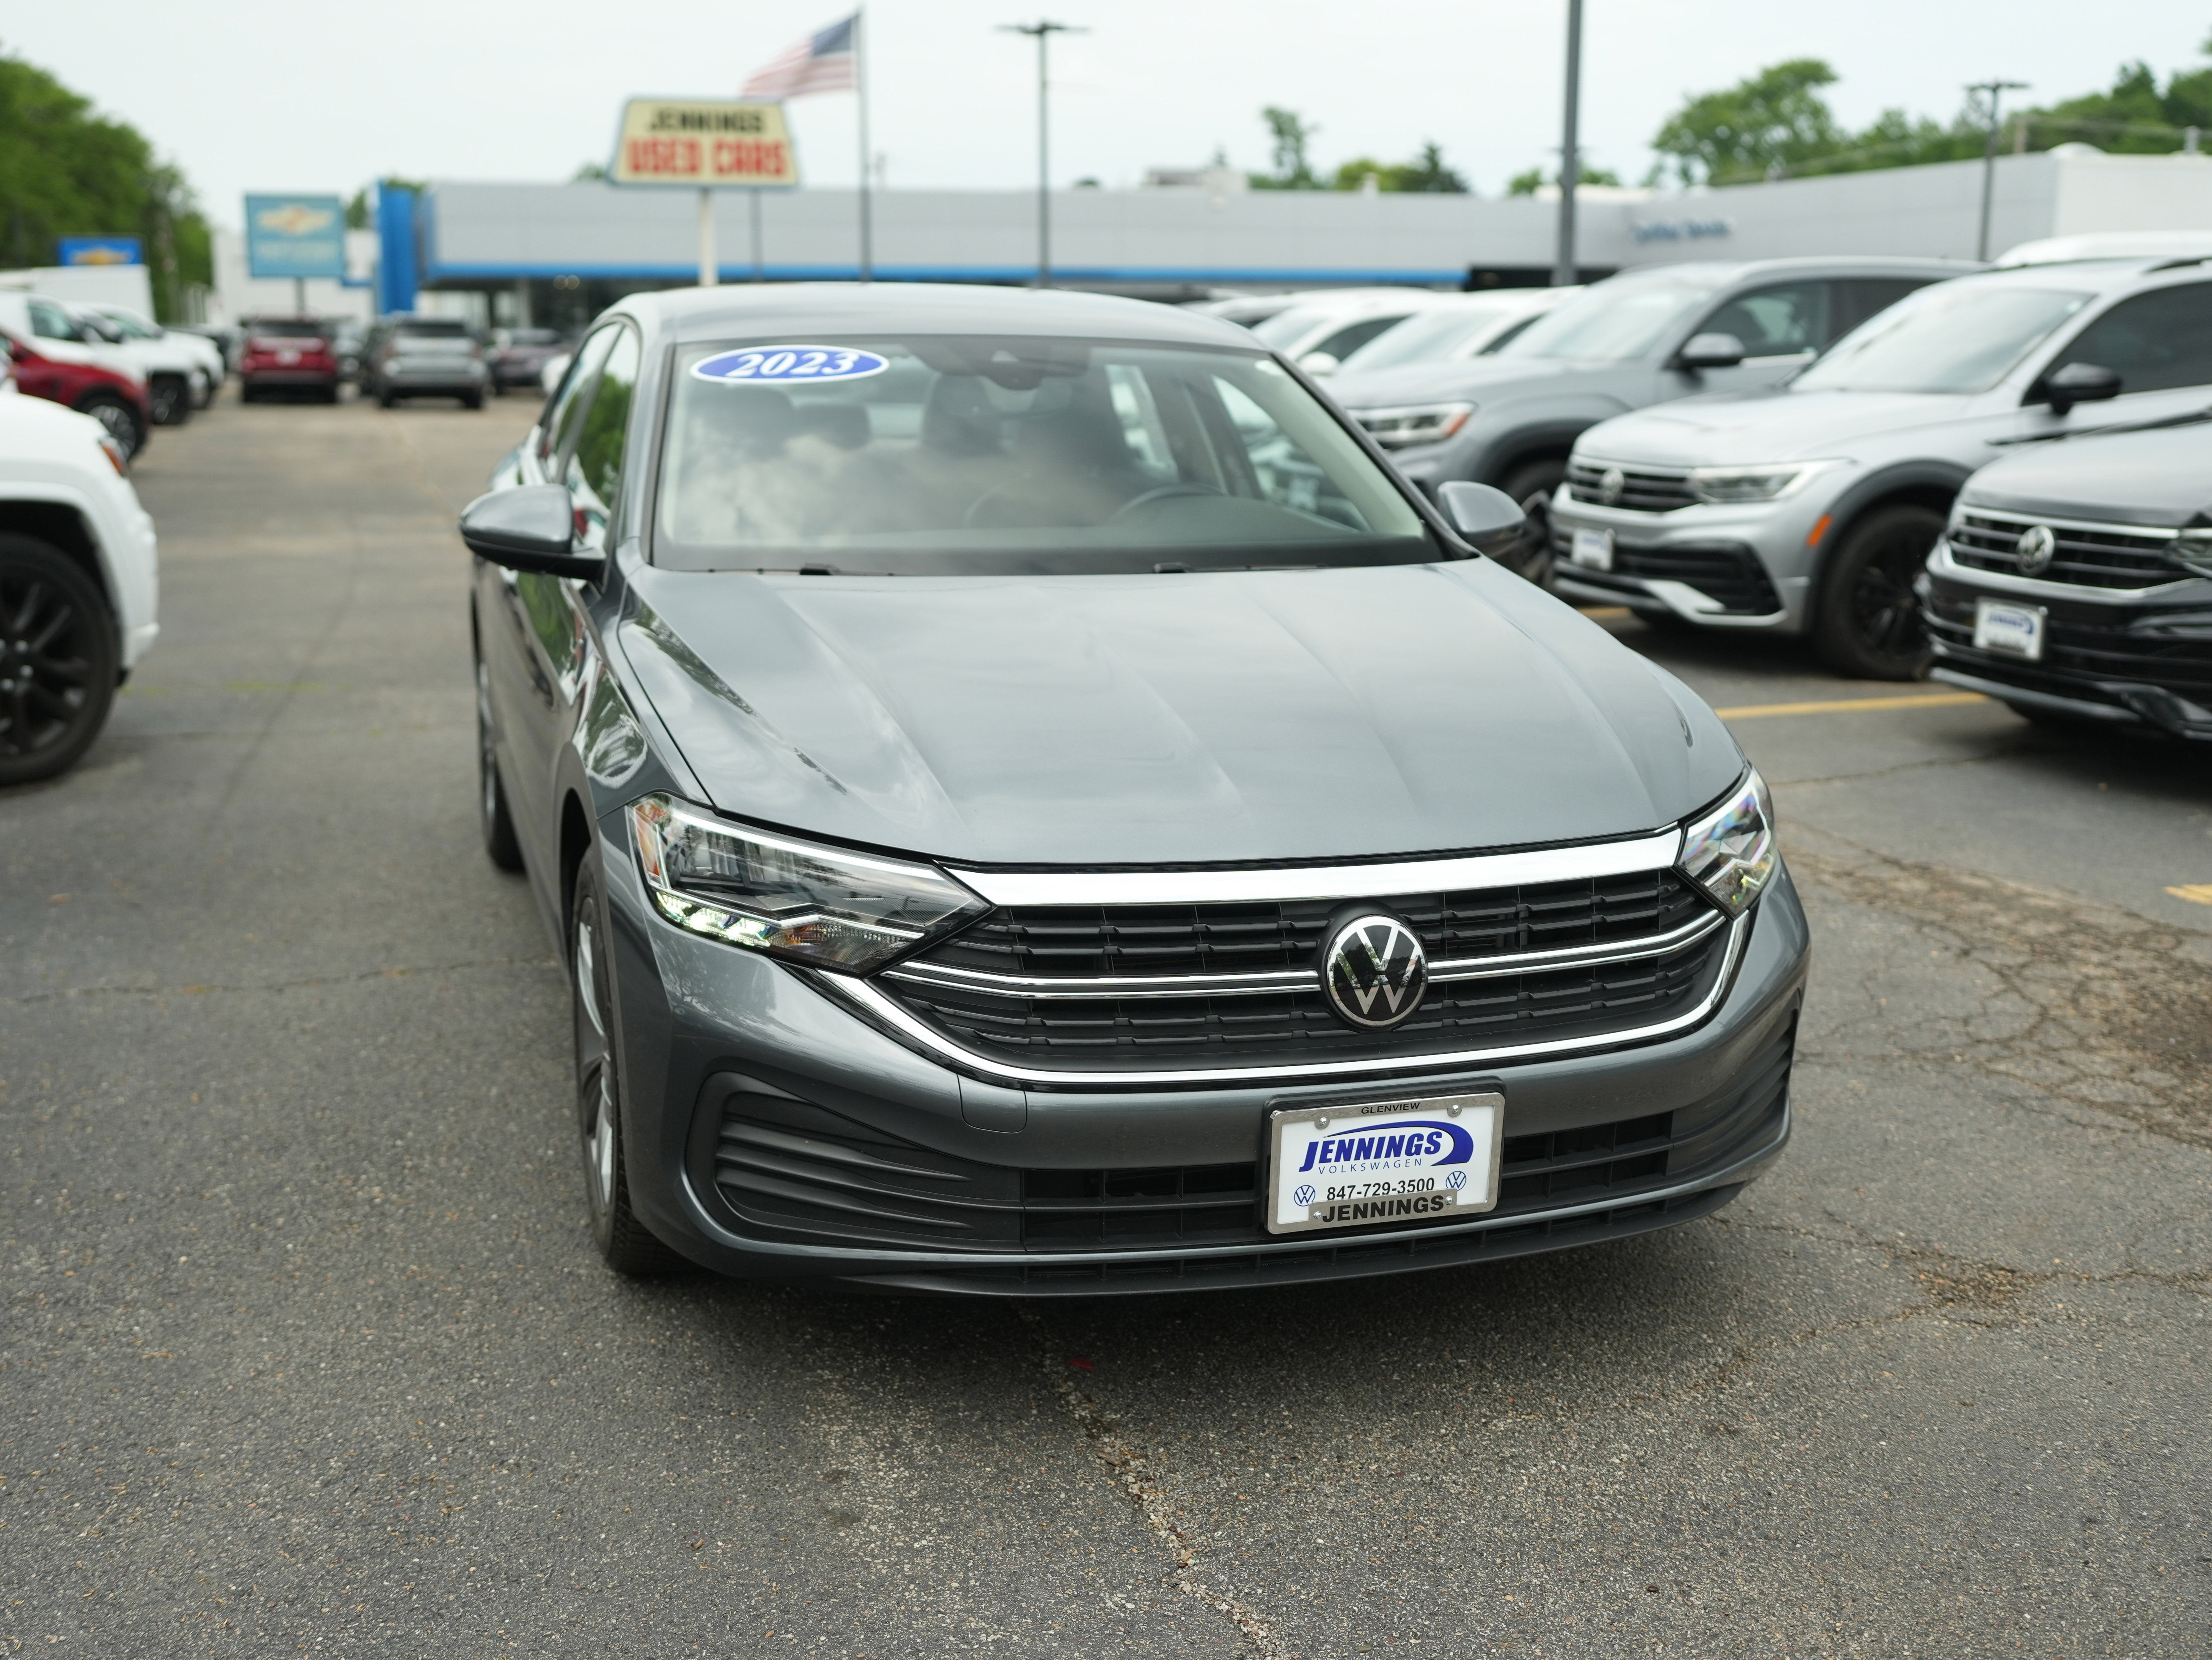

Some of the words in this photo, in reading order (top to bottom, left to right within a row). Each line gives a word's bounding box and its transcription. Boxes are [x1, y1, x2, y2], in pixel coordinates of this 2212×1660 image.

[650, 109, 763, 132] JENNINGS
[627, 137, 700, 175] USED
[712, 139, 786, 176] CARS
[725, 352, 860, 377] 2023
[1361, 1102, 1420, 1114] GLENVIEW
[1299, 1131, 1442, 1172] JENNINGS
[1319, 1158, 1422, 1175] VOLKSWAGEN
[1327, 1177, 1434, 1200] 847-729-3500
[1322, 1195, 1444, 1223] JENNINGS
